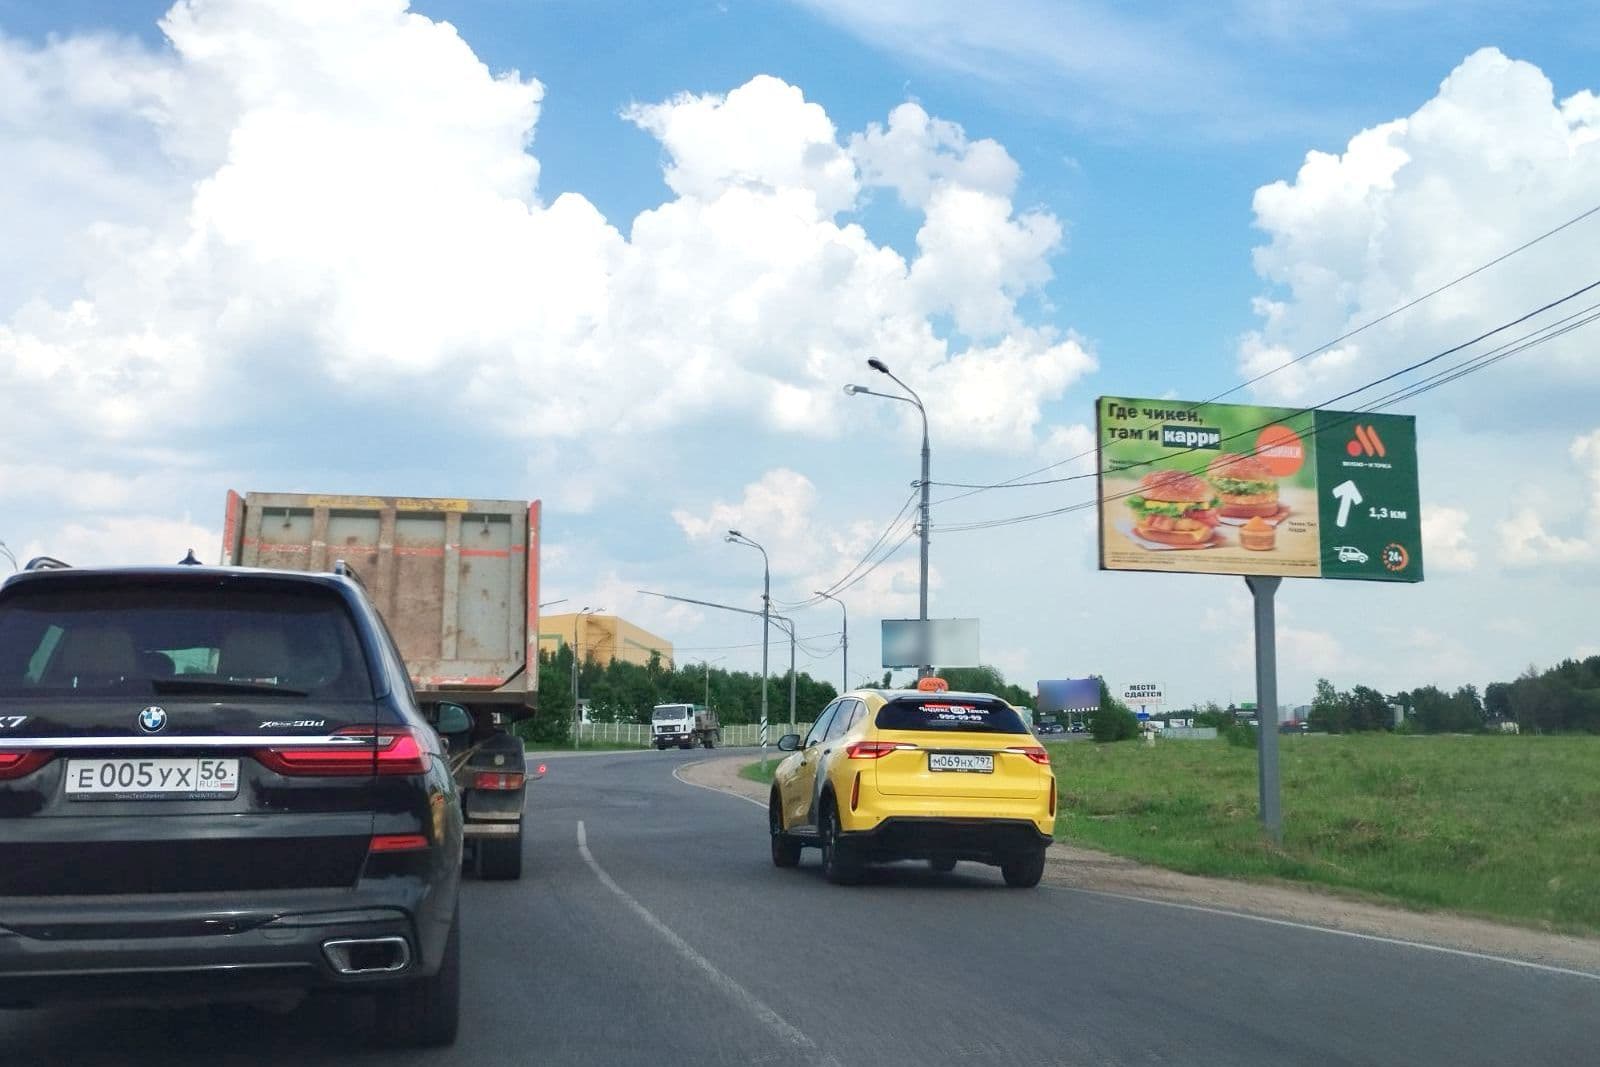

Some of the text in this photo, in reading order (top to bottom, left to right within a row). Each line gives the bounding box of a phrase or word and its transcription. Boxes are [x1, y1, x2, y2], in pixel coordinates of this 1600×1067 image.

[1108, 403, 1204, 424] Где чикен,
[1108, 428, 1220, 447] там и карри
[1369, 507, 1388, 520] 1,3
[201, 761, 227, 780] 56
[200, 780, 220, 788] RUS
